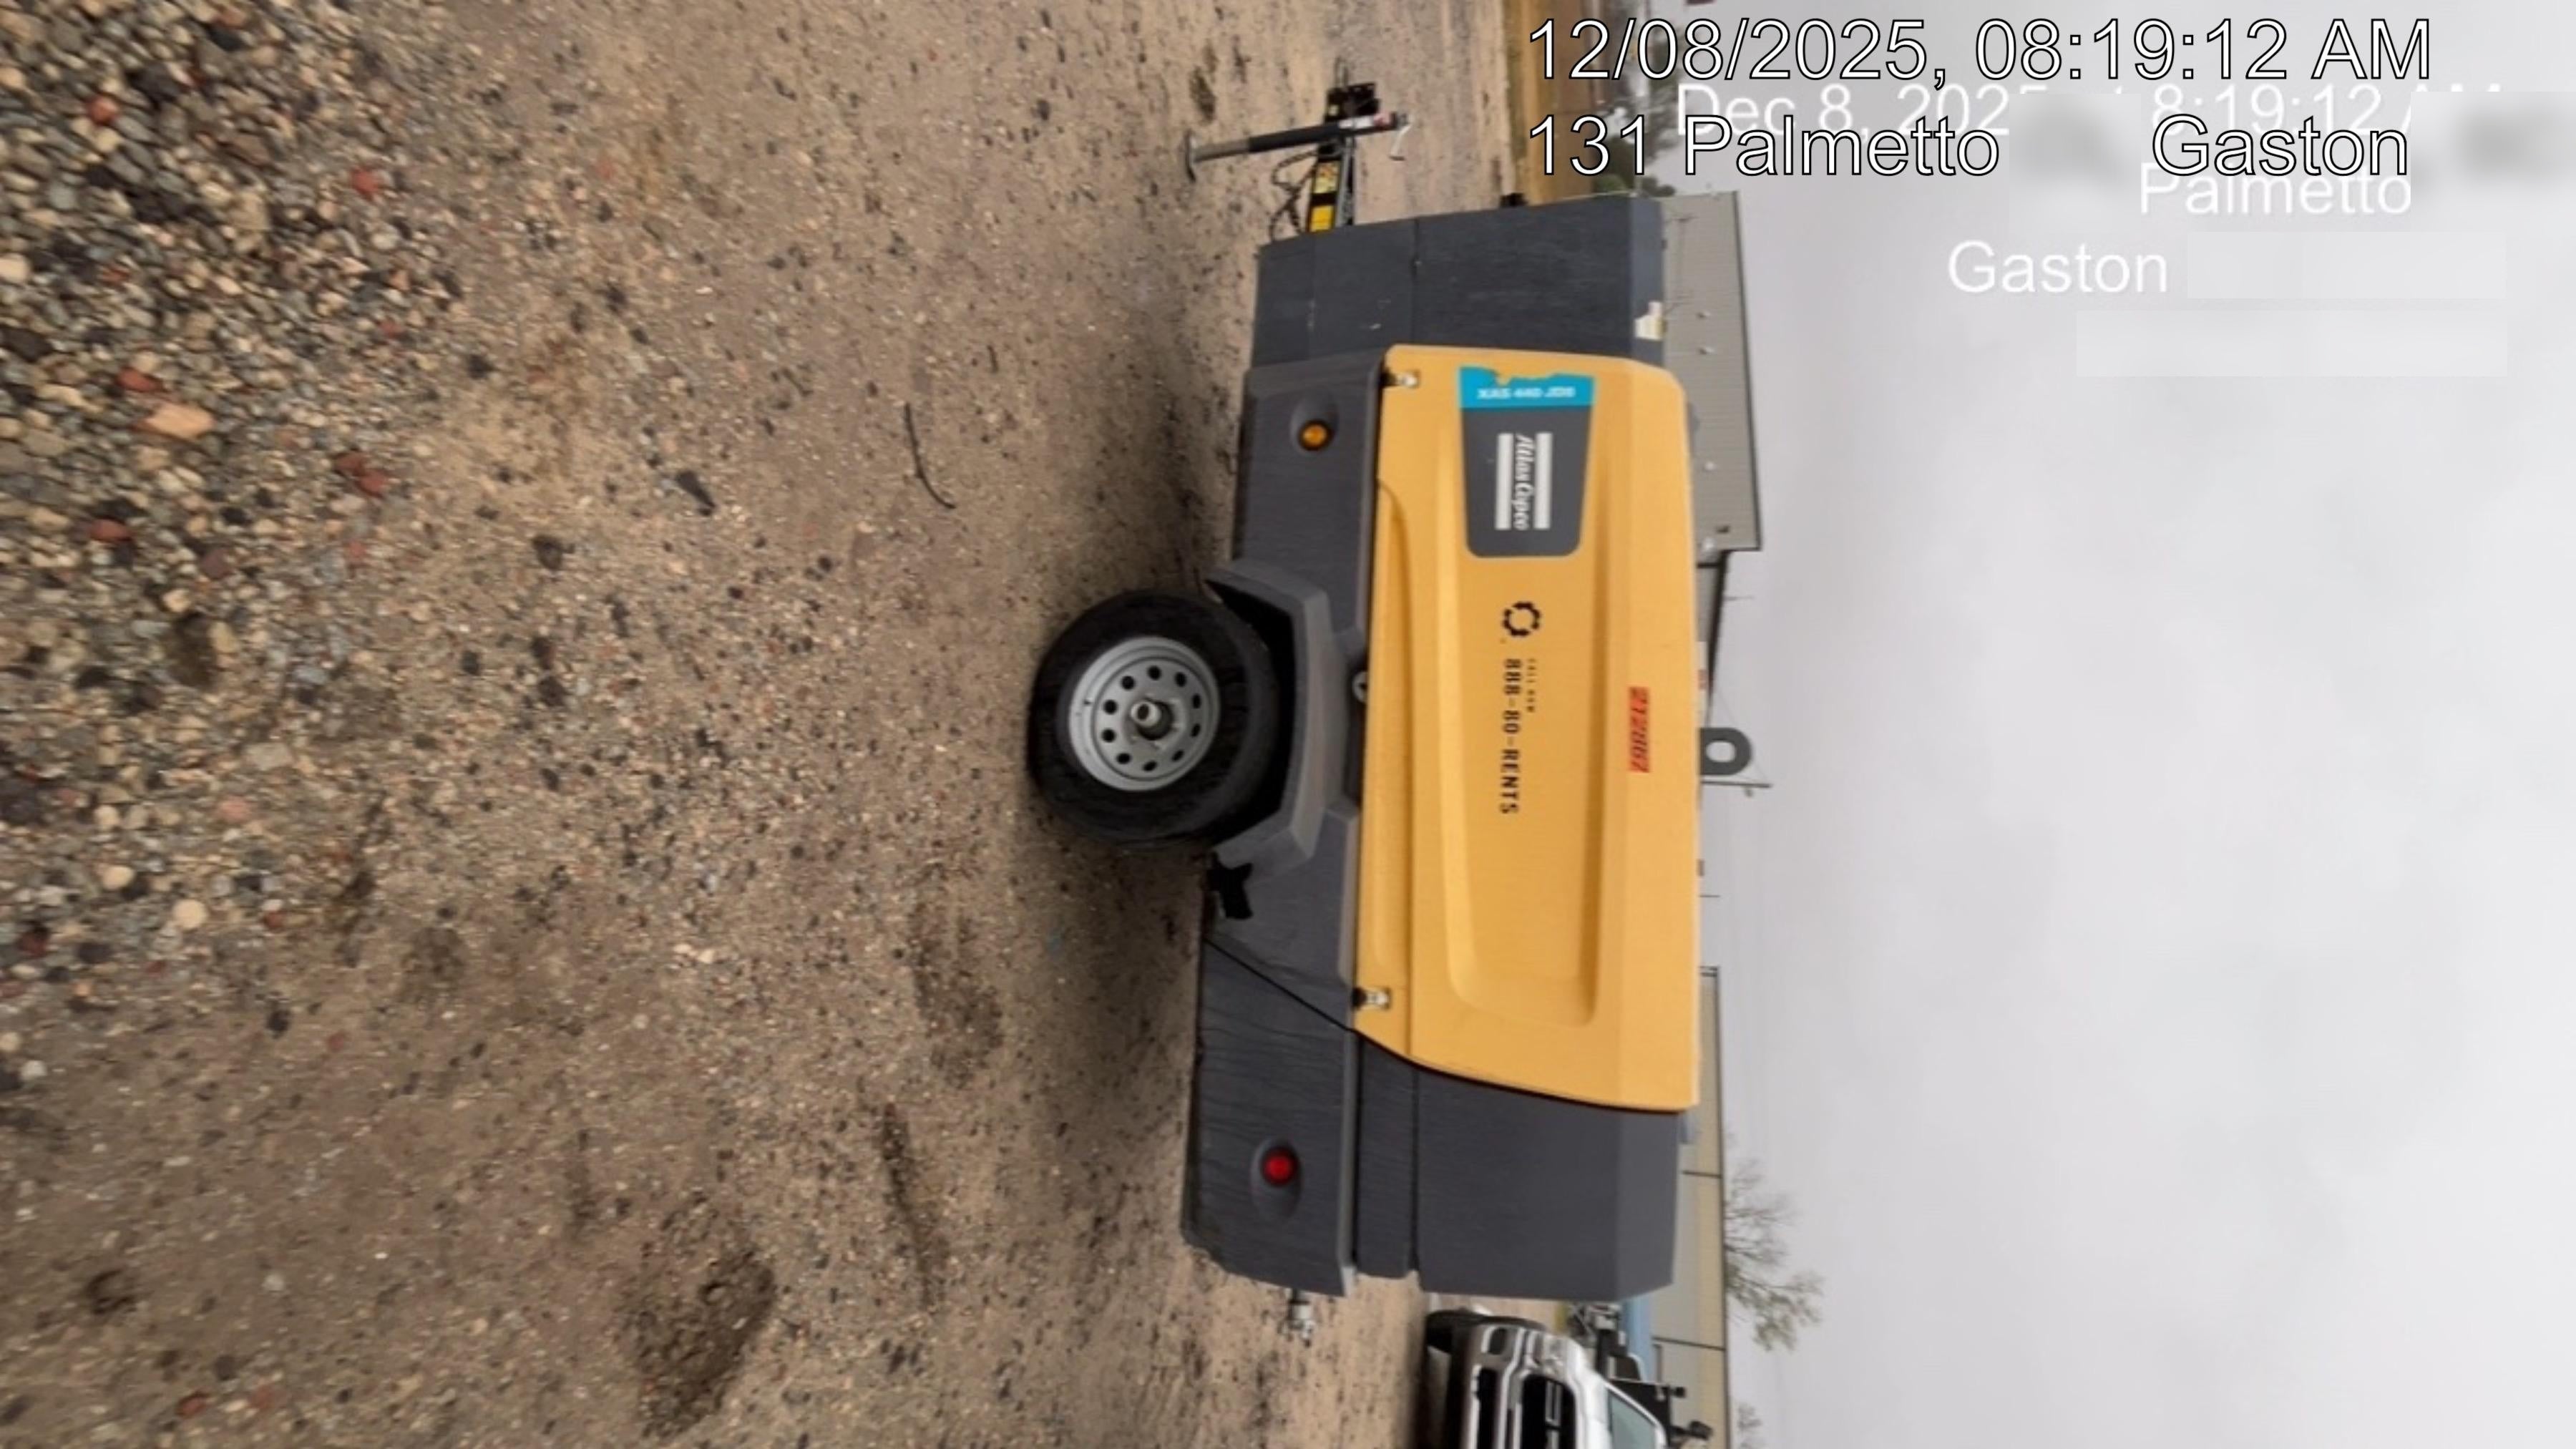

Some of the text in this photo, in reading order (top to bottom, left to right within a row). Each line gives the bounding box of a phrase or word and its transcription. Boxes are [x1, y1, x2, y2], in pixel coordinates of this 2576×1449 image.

[1511, 434, 1536, 530] Atlas Copco
[1500, 658, 1522, 814] 888-80-RENTS
